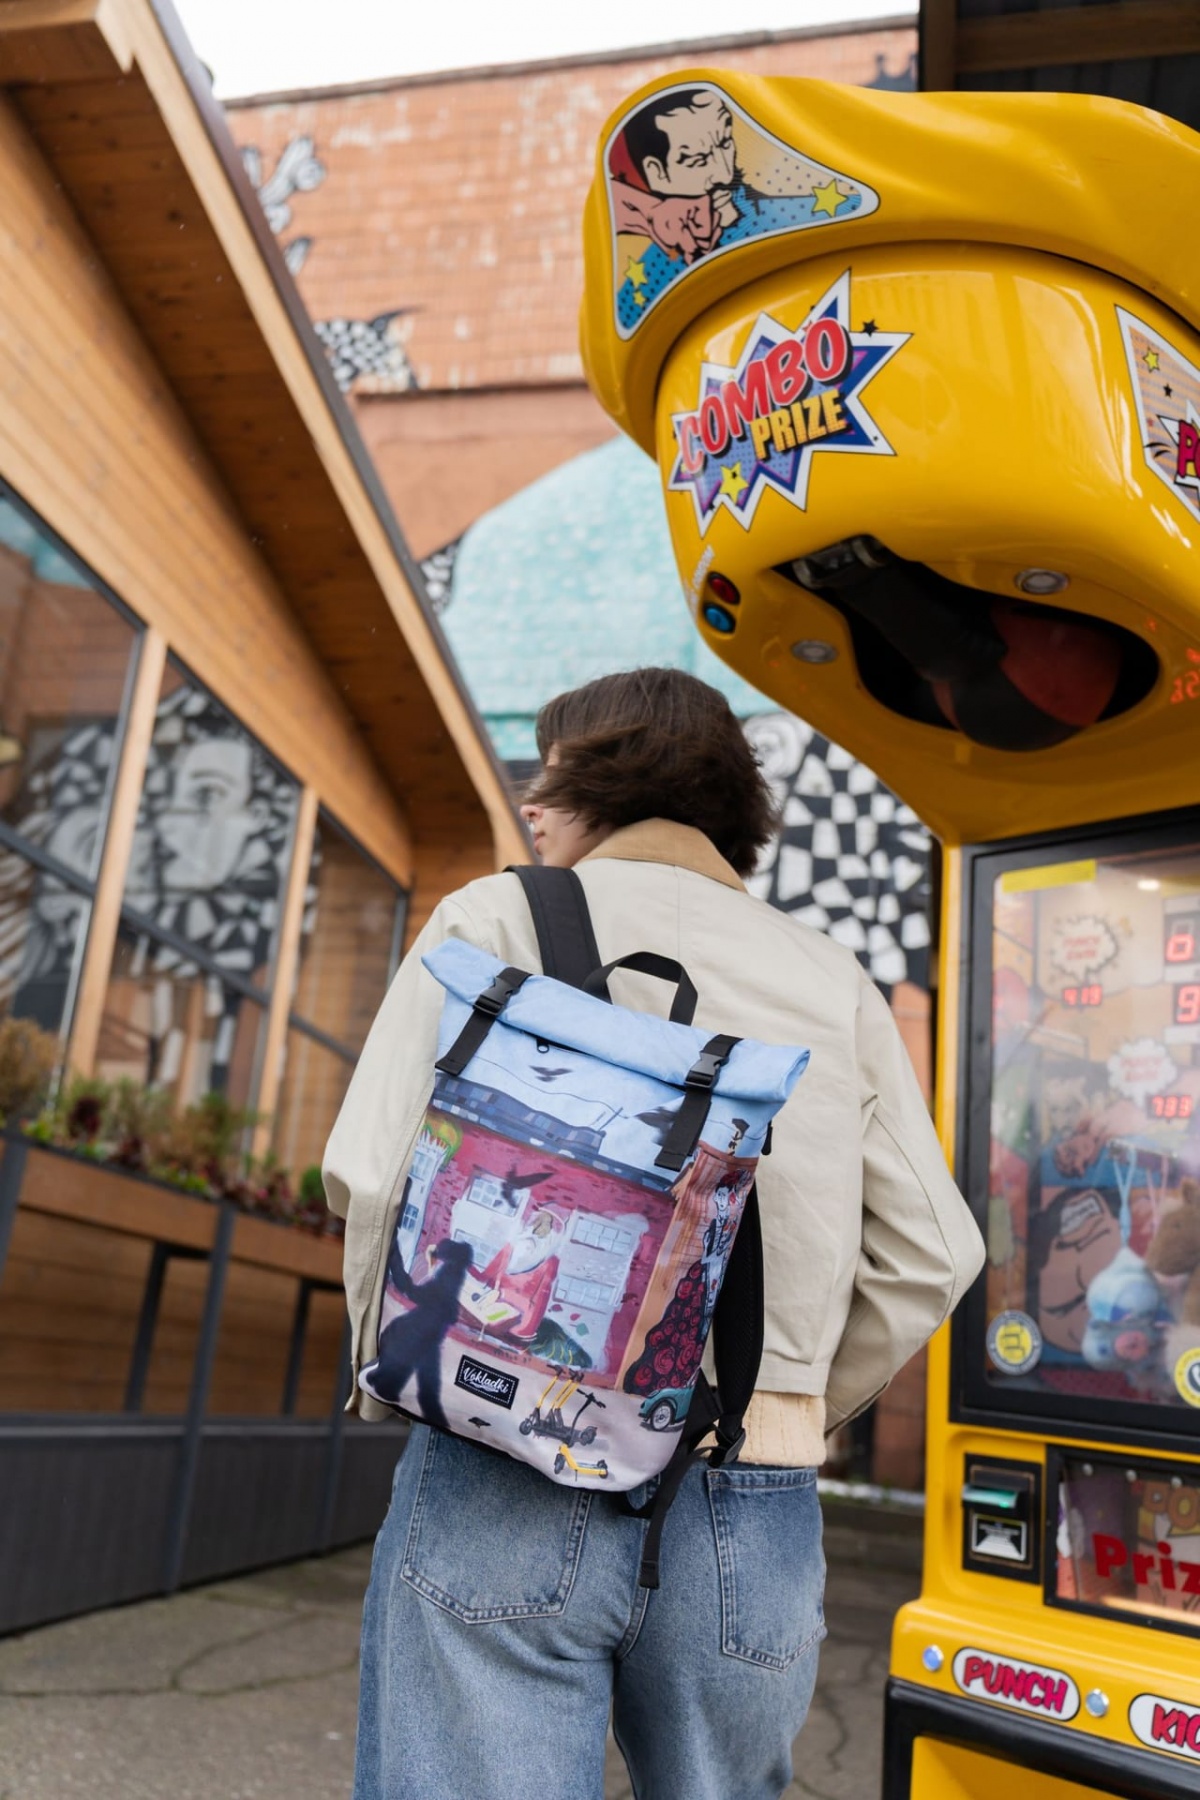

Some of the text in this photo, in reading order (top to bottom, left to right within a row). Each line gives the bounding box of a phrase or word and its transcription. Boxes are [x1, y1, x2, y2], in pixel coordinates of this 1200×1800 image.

[680, 317, 848, 474] COMBO
[750, 388, 848, 460] PRIZE
[463, 1366, 509, 1394] Vokladki
[963, 1656, 1069, 1714] PUNCH
